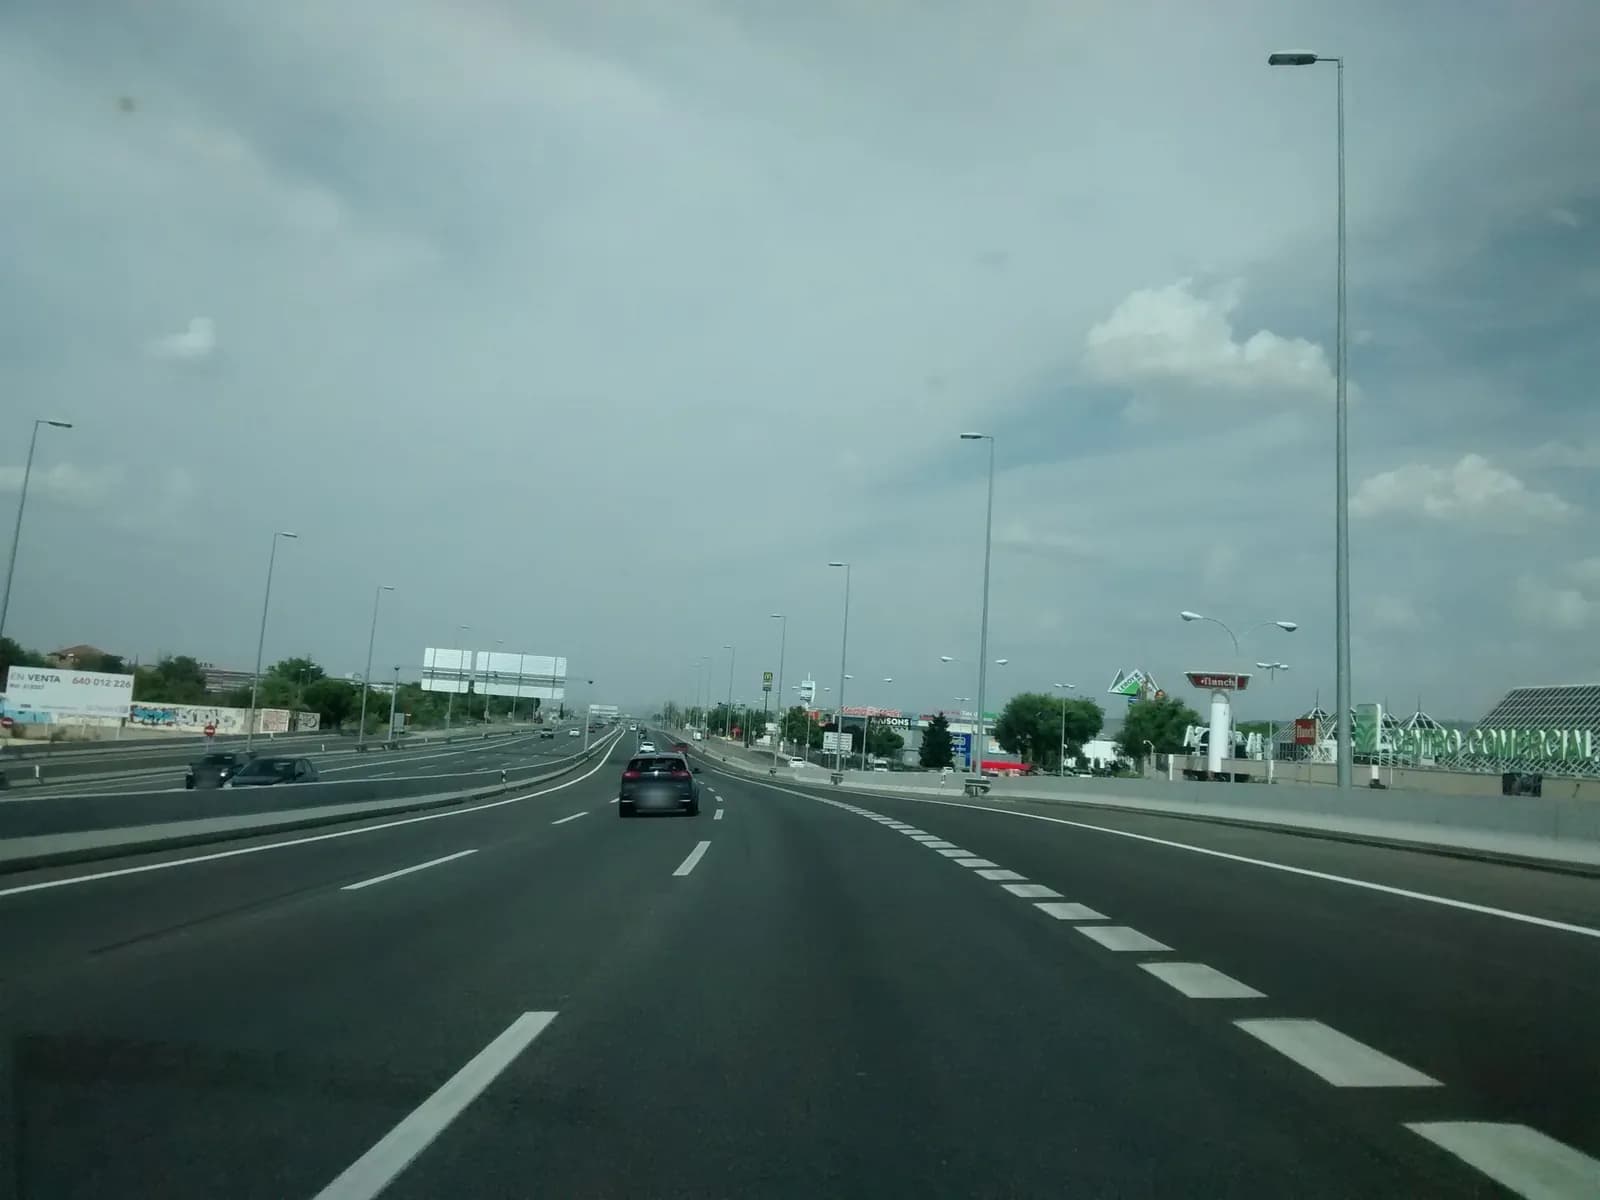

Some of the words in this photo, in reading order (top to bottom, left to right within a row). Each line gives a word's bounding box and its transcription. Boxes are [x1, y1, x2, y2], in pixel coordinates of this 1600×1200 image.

[10, 671, 25, 681] EN
[28, 674, 61, 683] VENTA
[72, 676, 91, 685] 640
[94, 678, 113, 688] 012
[114, 680, 131, 689] 226
[1391, 728, 1461, 756] CENTRO
[1468, 728, 1597, 760] COMERCIAL
